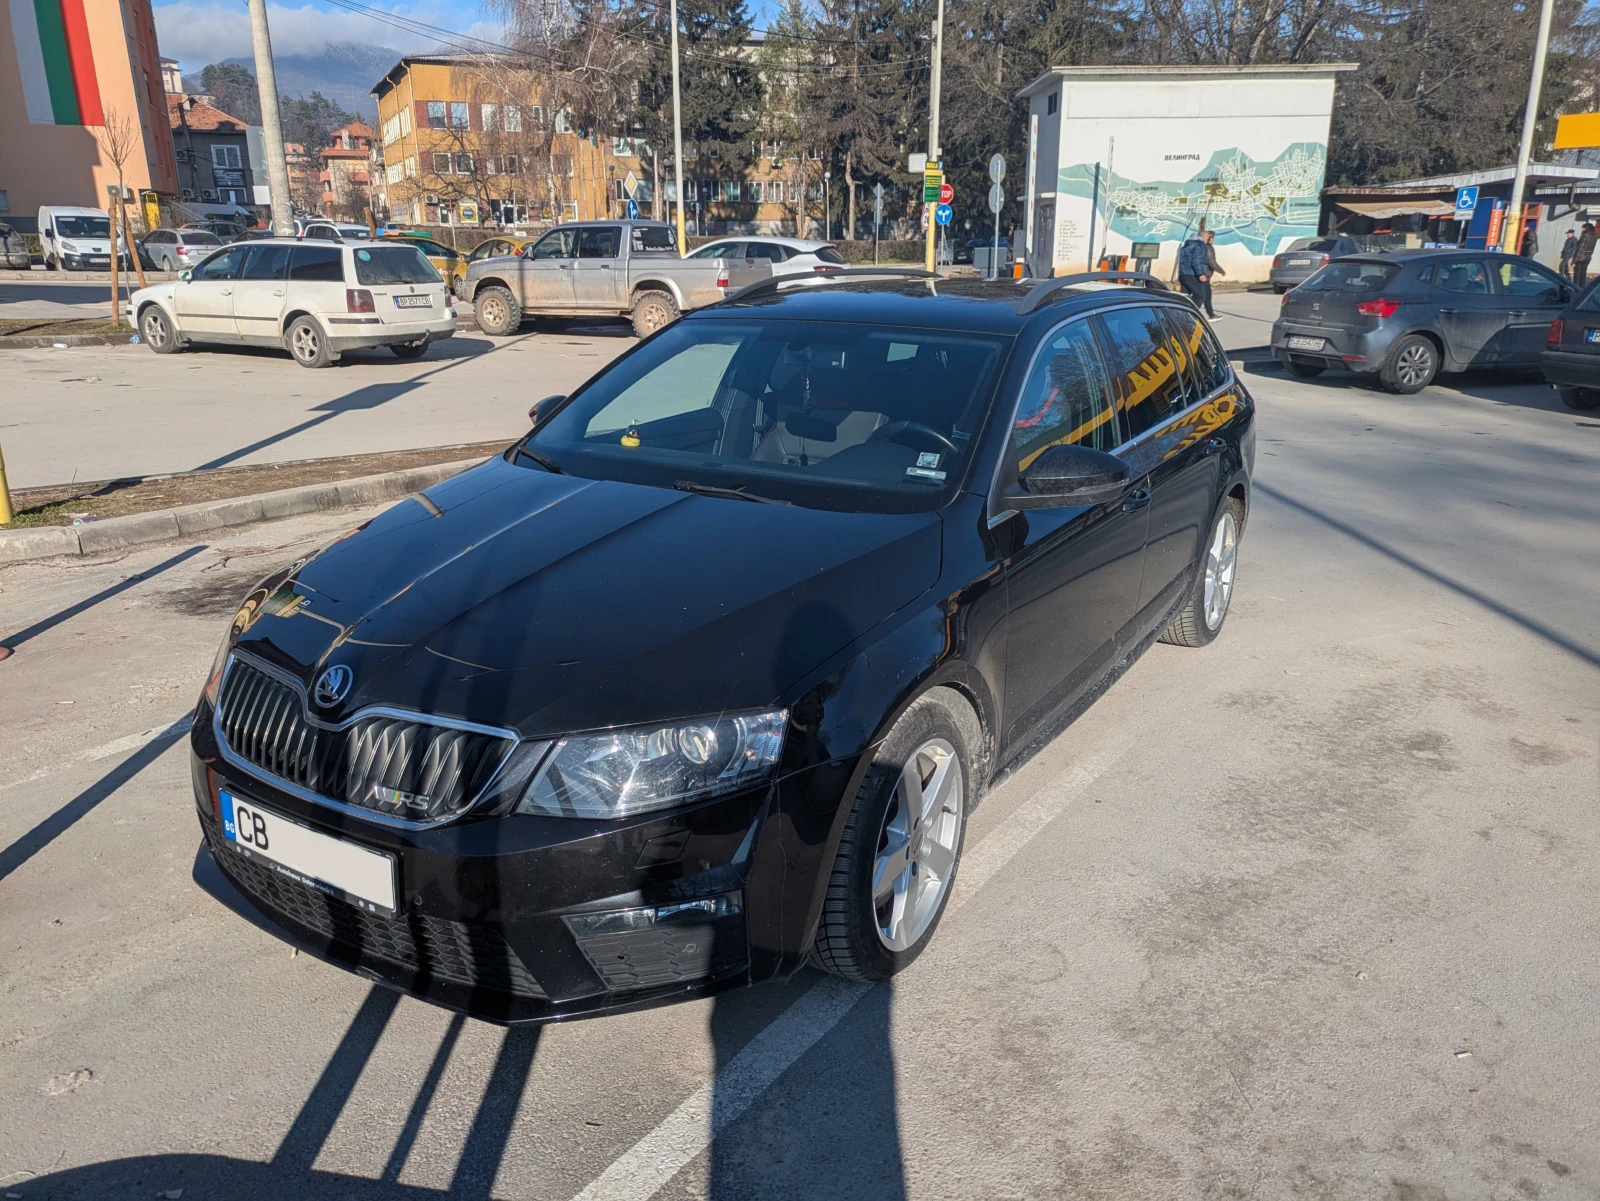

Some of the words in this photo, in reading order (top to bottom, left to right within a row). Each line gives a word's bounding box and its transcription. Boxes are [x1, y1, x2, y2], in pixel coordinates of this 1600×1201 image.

[1164, 153, 1201, 161] ВЕЛИНГРАД
[941, 190, 952, 198] TOP
[1490, 211, 1499, 245] СПОРТ
[407, 297, 422, 305] 2571
[224, 819, 235, 834] BG
[237, 806, 269, 851] CB
[277, 865, 301, 881] Autohaus
